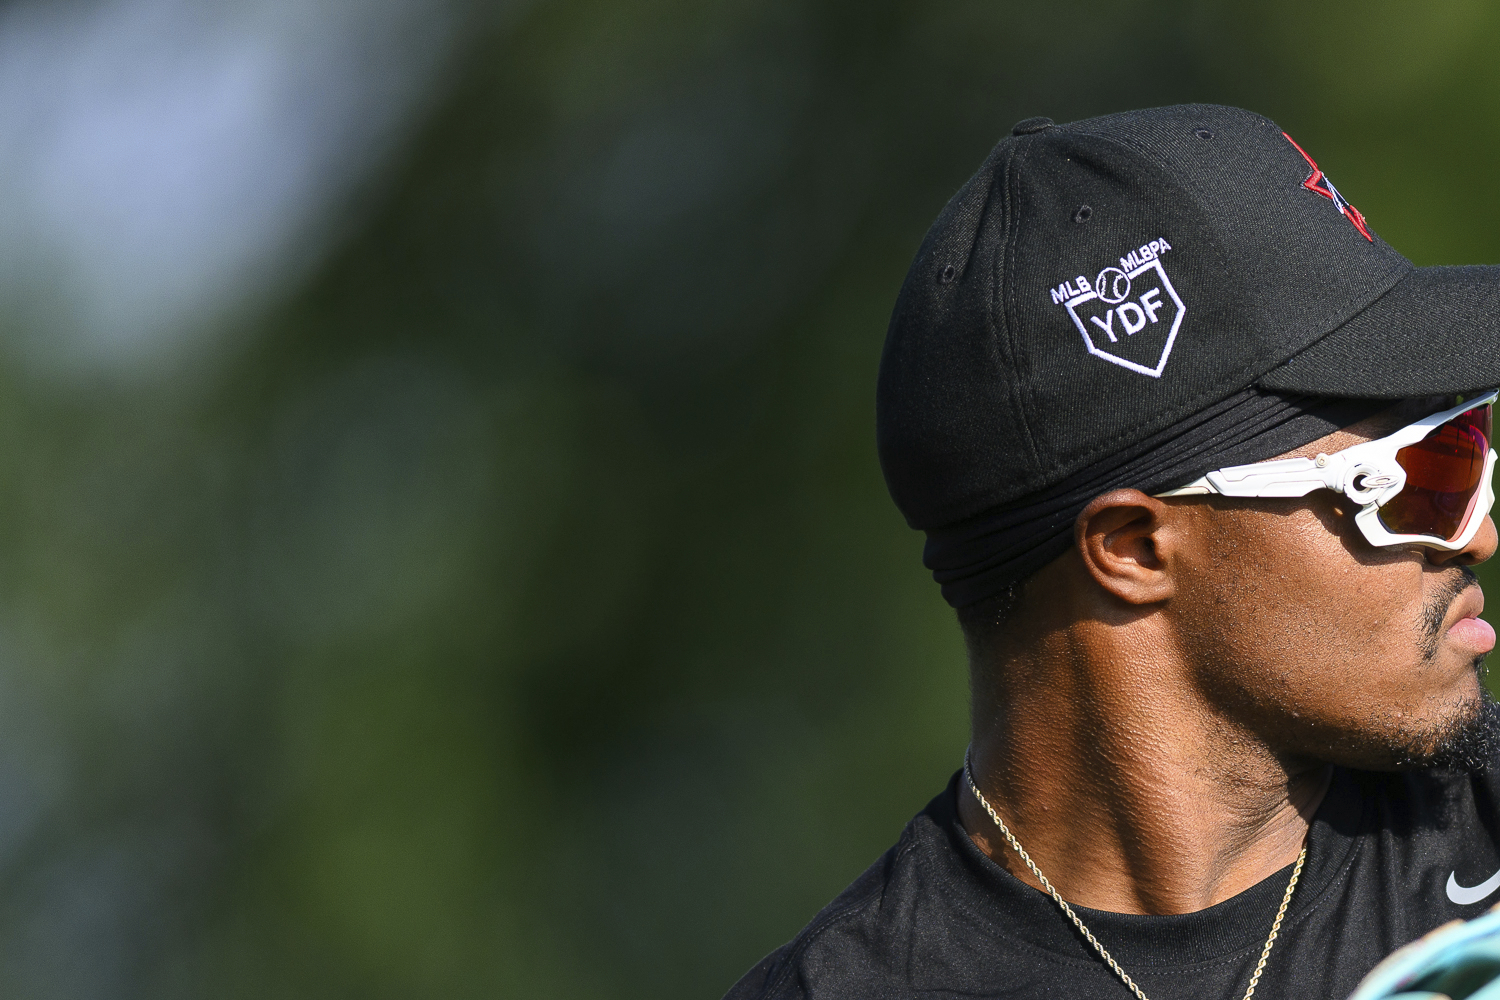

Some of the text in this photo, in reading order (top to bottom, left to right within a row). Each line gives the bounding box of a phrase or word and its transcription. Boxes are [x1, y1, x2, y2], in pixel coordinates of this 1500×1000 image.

[1050, 237, 1172, 304] MLB MLBPA
[1090, 287, 1164, 343] YDF
